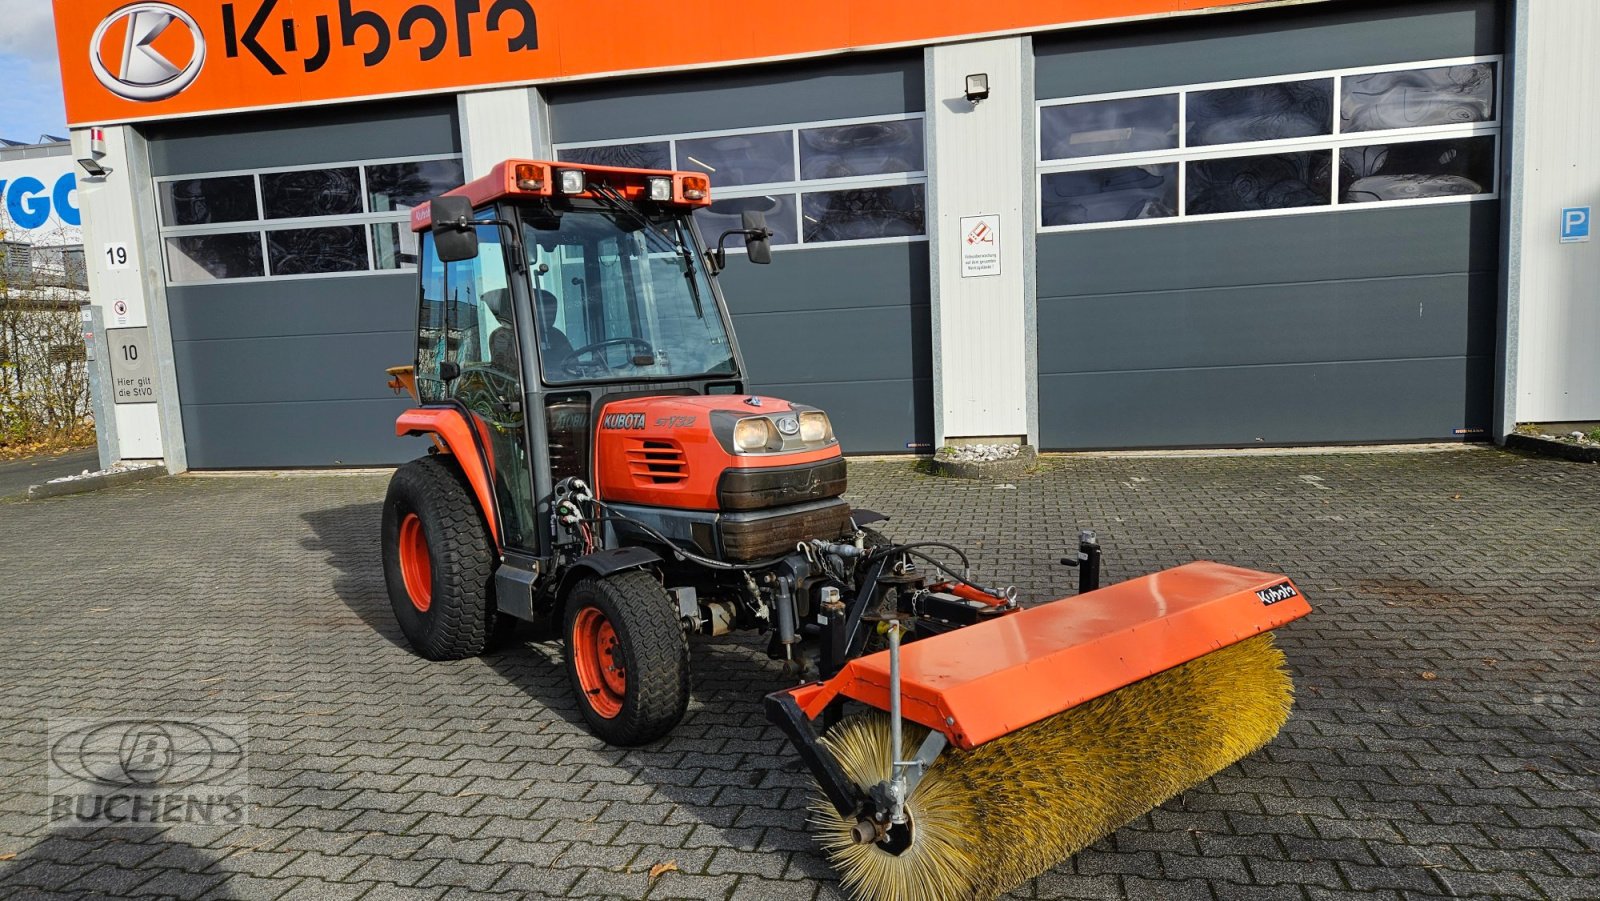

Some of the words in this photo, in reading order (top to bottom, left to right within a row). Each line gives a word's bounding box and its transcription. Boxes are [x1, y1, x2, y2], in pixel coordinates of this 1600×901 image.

[221, 0, 539, 75] Kubota
[1565, 211, 1586, 234] P
[106, 247, 128, 265] 19
[122, 344, 138, 361] 10
[117, 377, 134, 386] Hier
[138, 376, 151, 387] gilt
[118, 388, 131, 397] die
[133, 387, 152, 396] StVO
[603, 412, 646, 430] KUBOTA
[1256, 584, 1297, 604] Kubota
